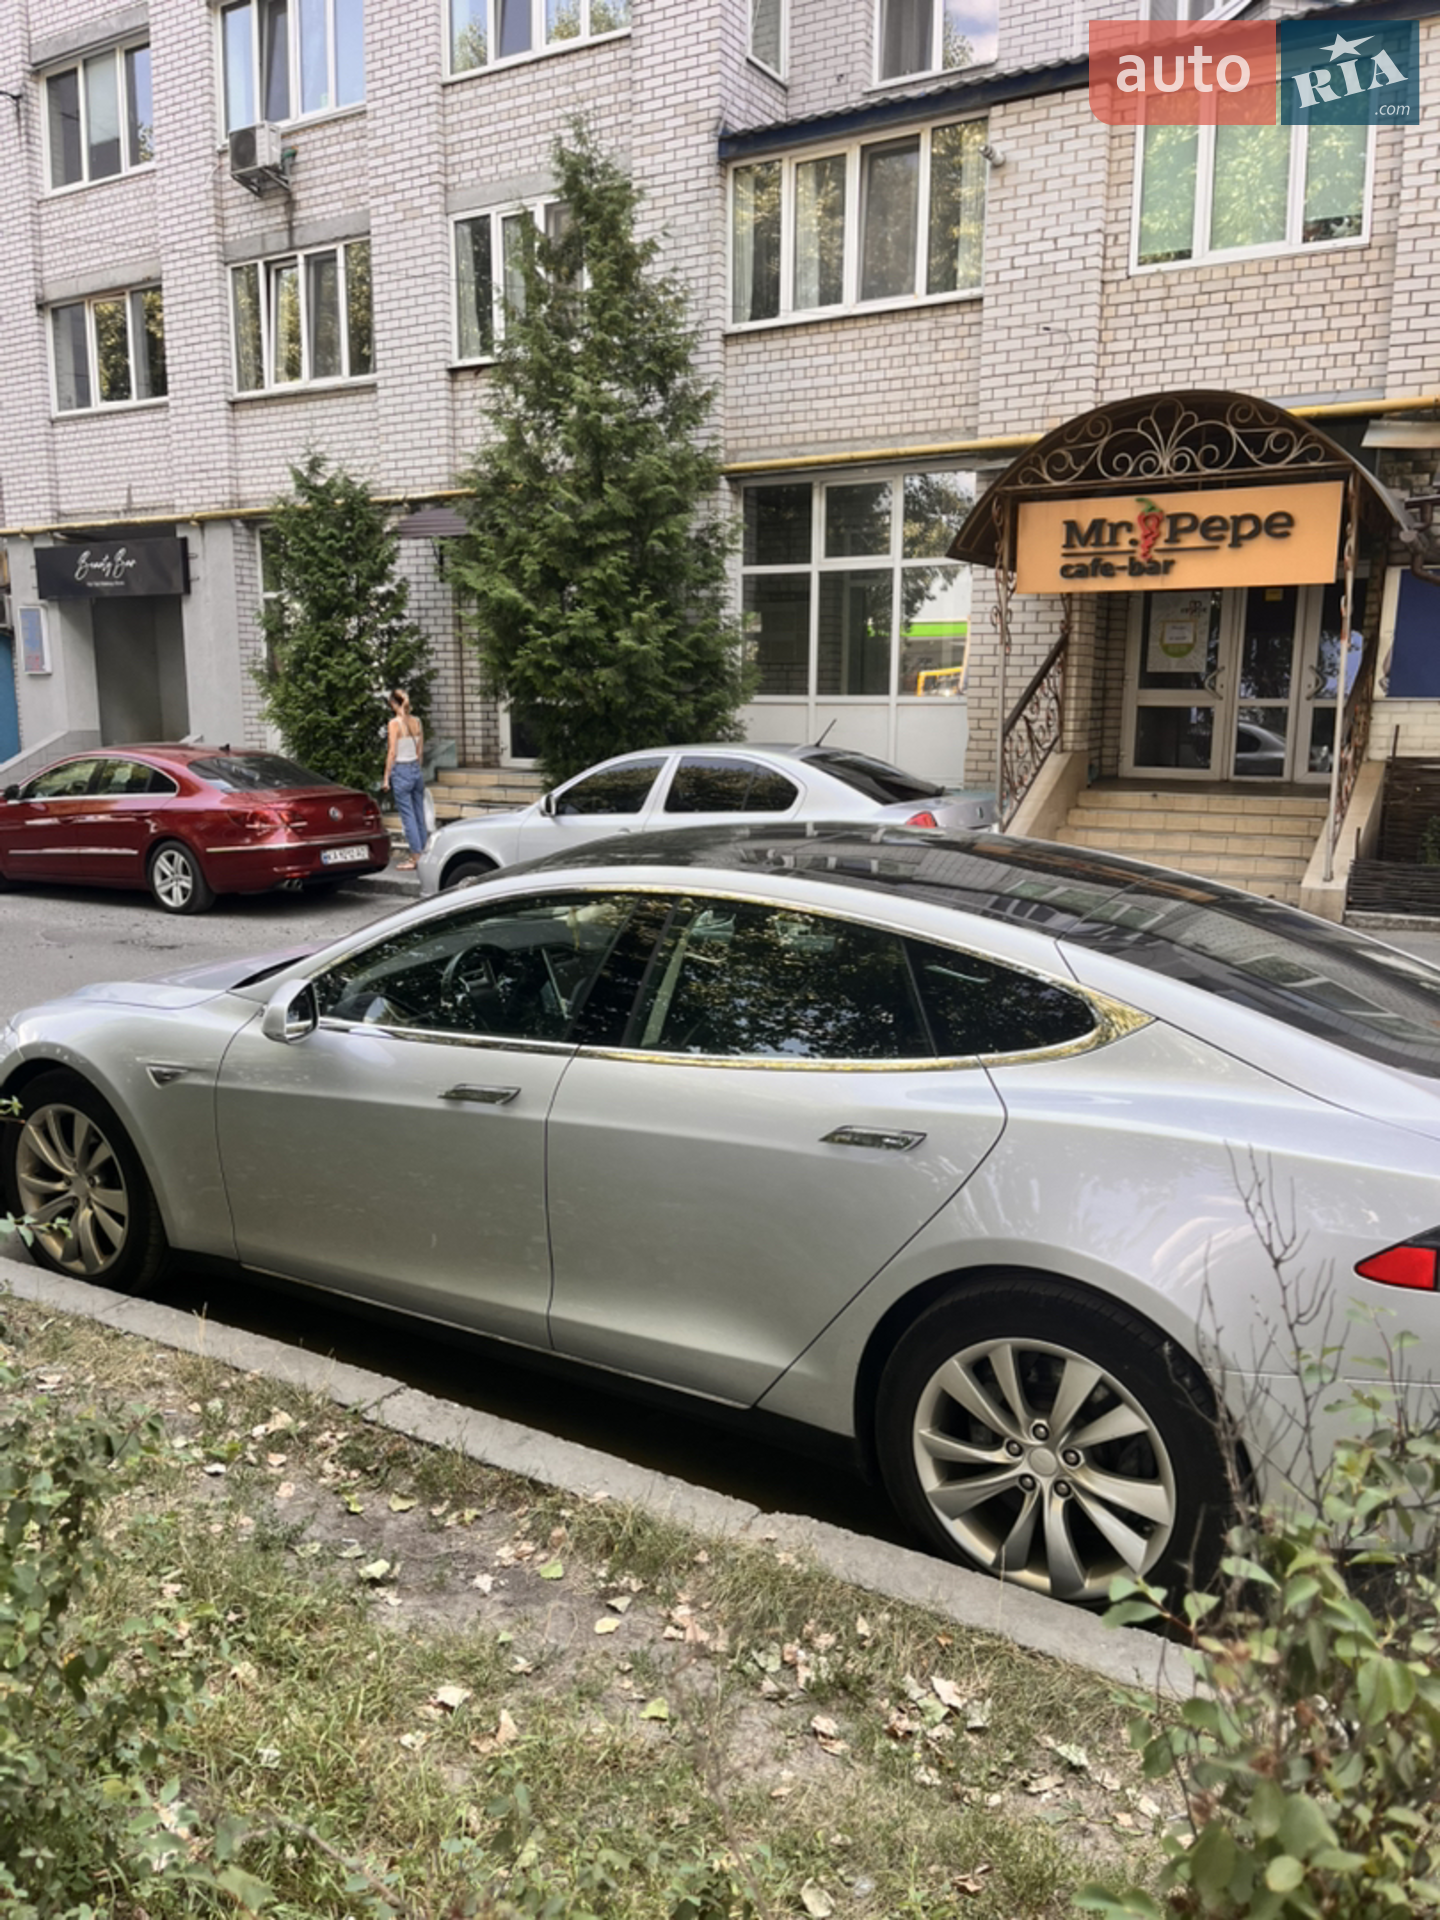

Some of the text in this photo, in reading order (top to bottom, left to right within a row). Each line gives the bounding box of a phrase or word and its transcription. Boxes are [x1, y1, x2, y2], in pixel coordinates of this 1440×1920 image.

[1061, 510, 1295, 549] Mr. Pepe
[1059, 556, 1176, 580] cafe-bar
